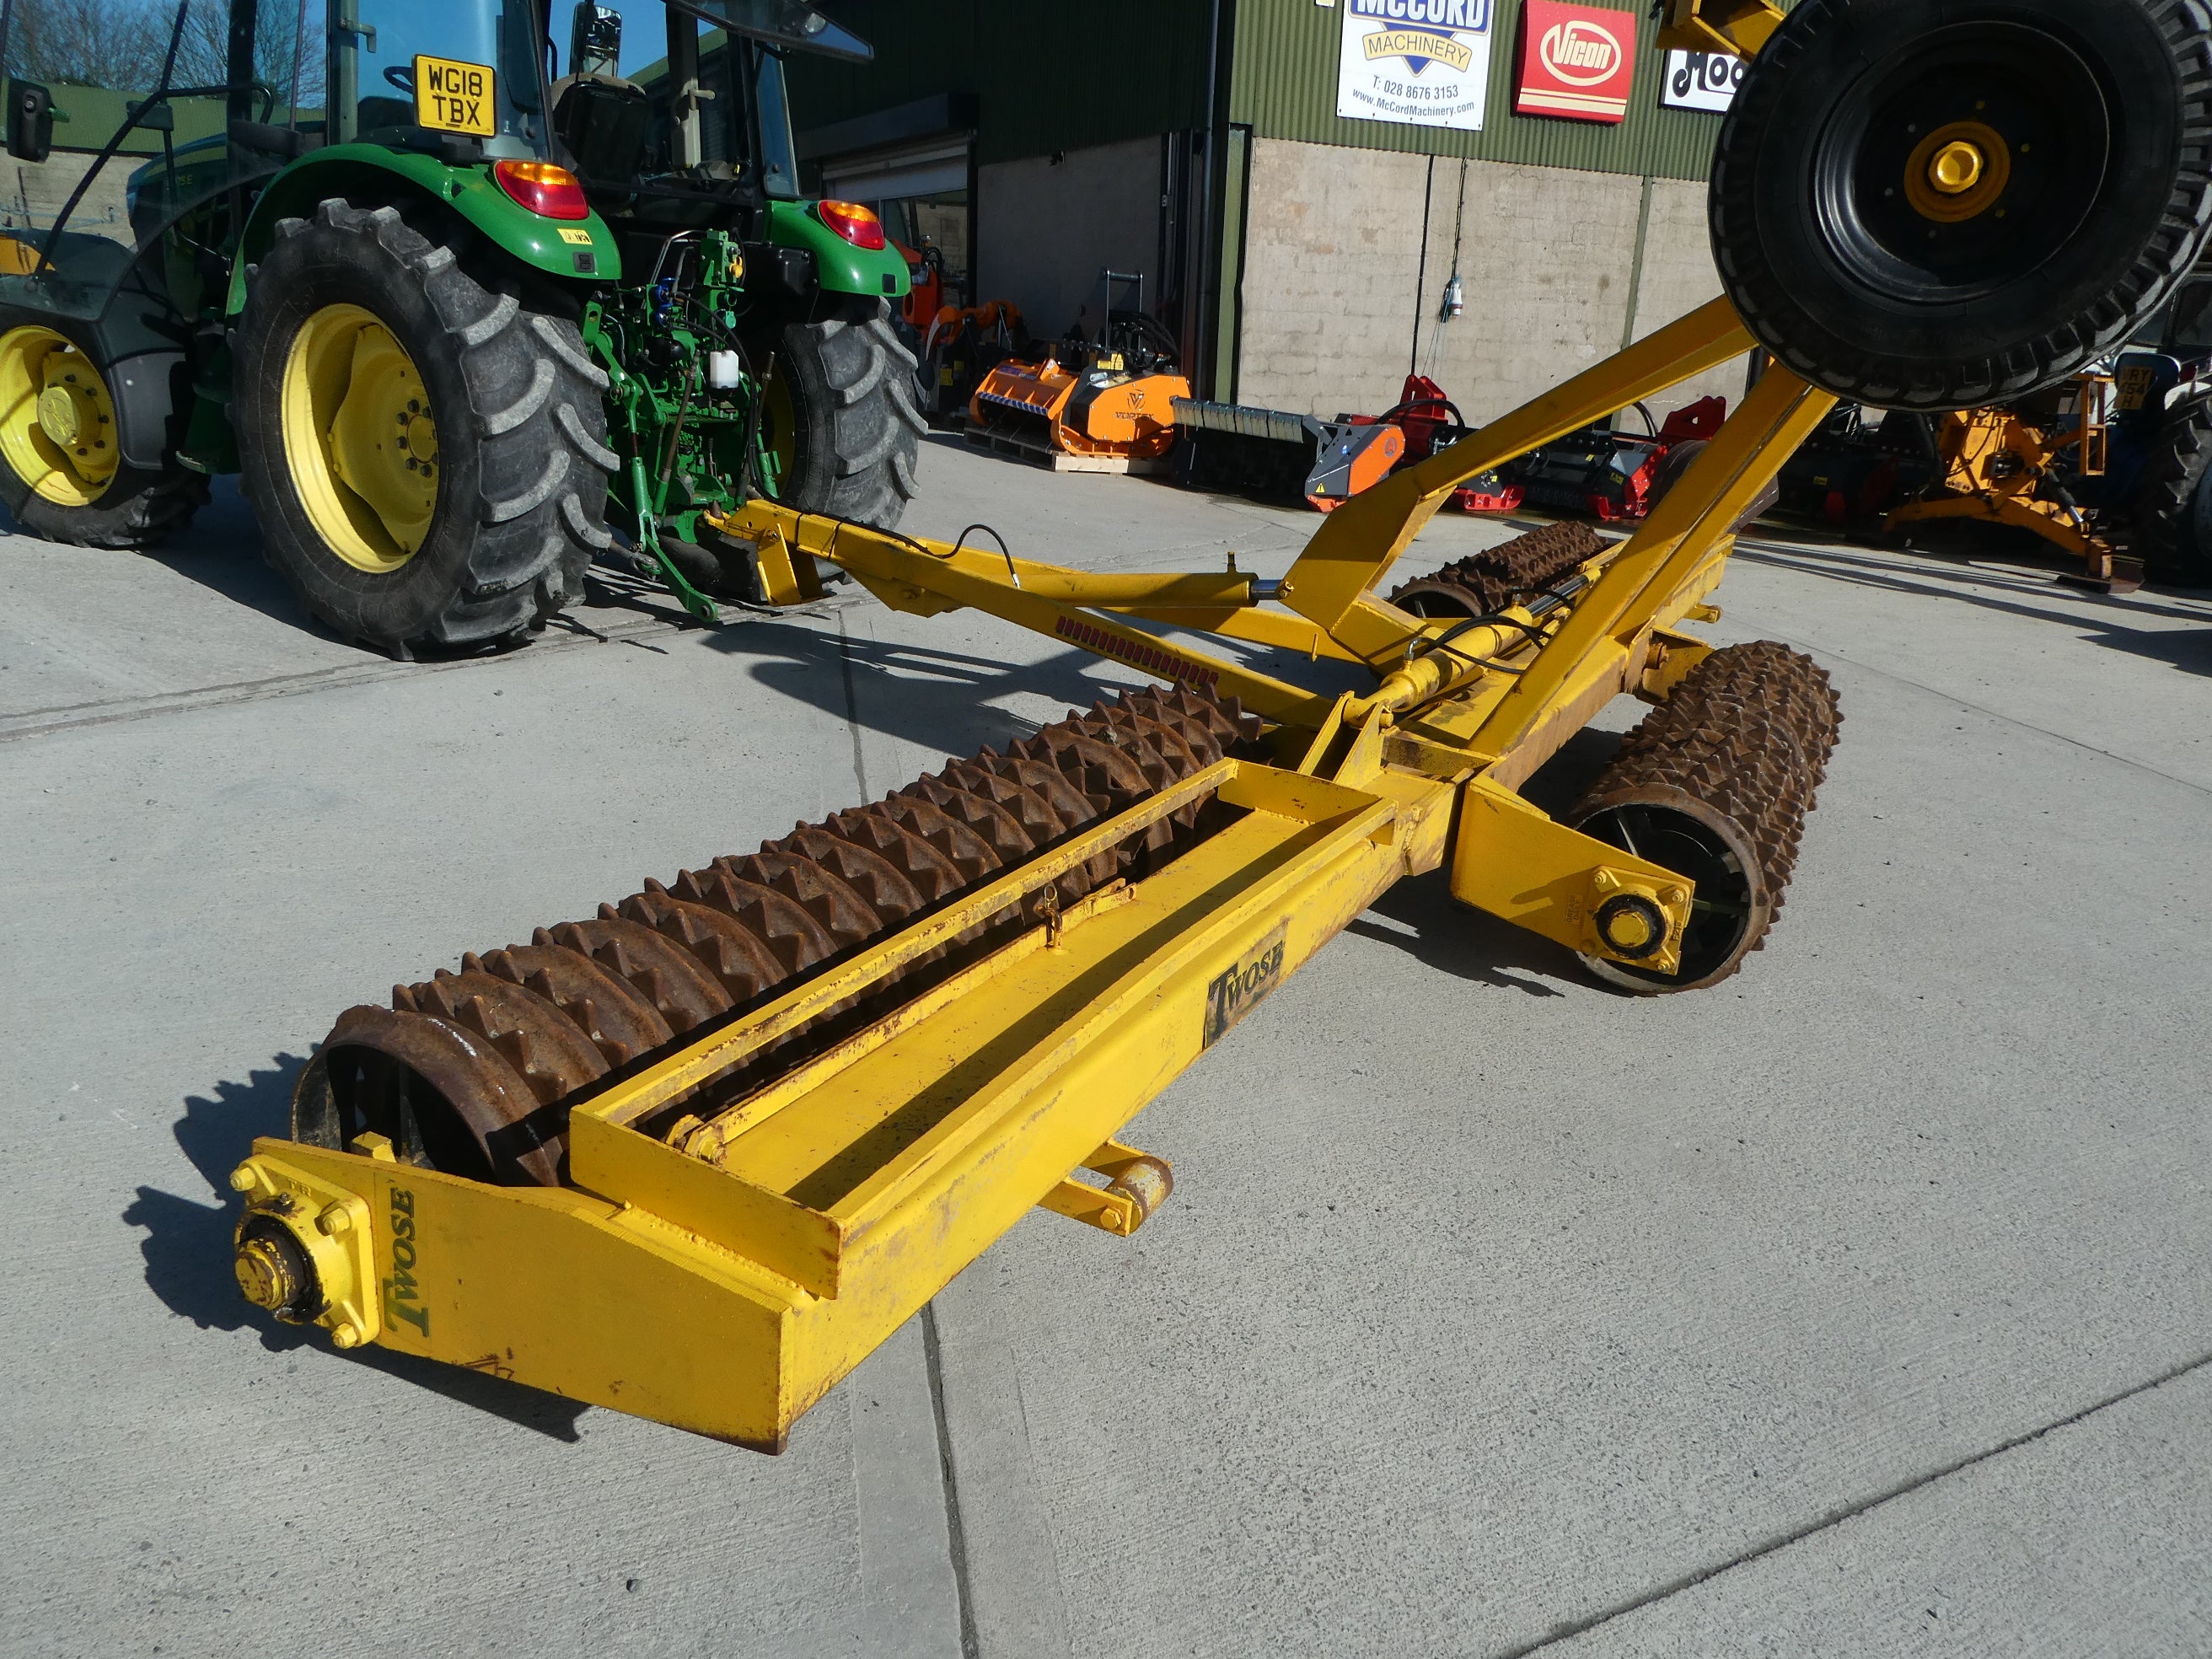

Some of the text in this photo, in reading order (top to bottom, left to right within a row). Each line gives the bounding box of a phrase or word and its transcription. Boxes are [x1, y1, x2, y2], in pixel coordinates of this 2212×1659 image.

[1368, 34, 1468, 64] MACHINERY
[1552, 23, 1612, 70] Vicon
[428, 64, 482, 98] WG18
[1373, 74, 1459, 99] T: 028 8676 3153
[432, 94, 481, 127] TBX
[1352, 89, 1475, 116] www.McCordMachinery.com
